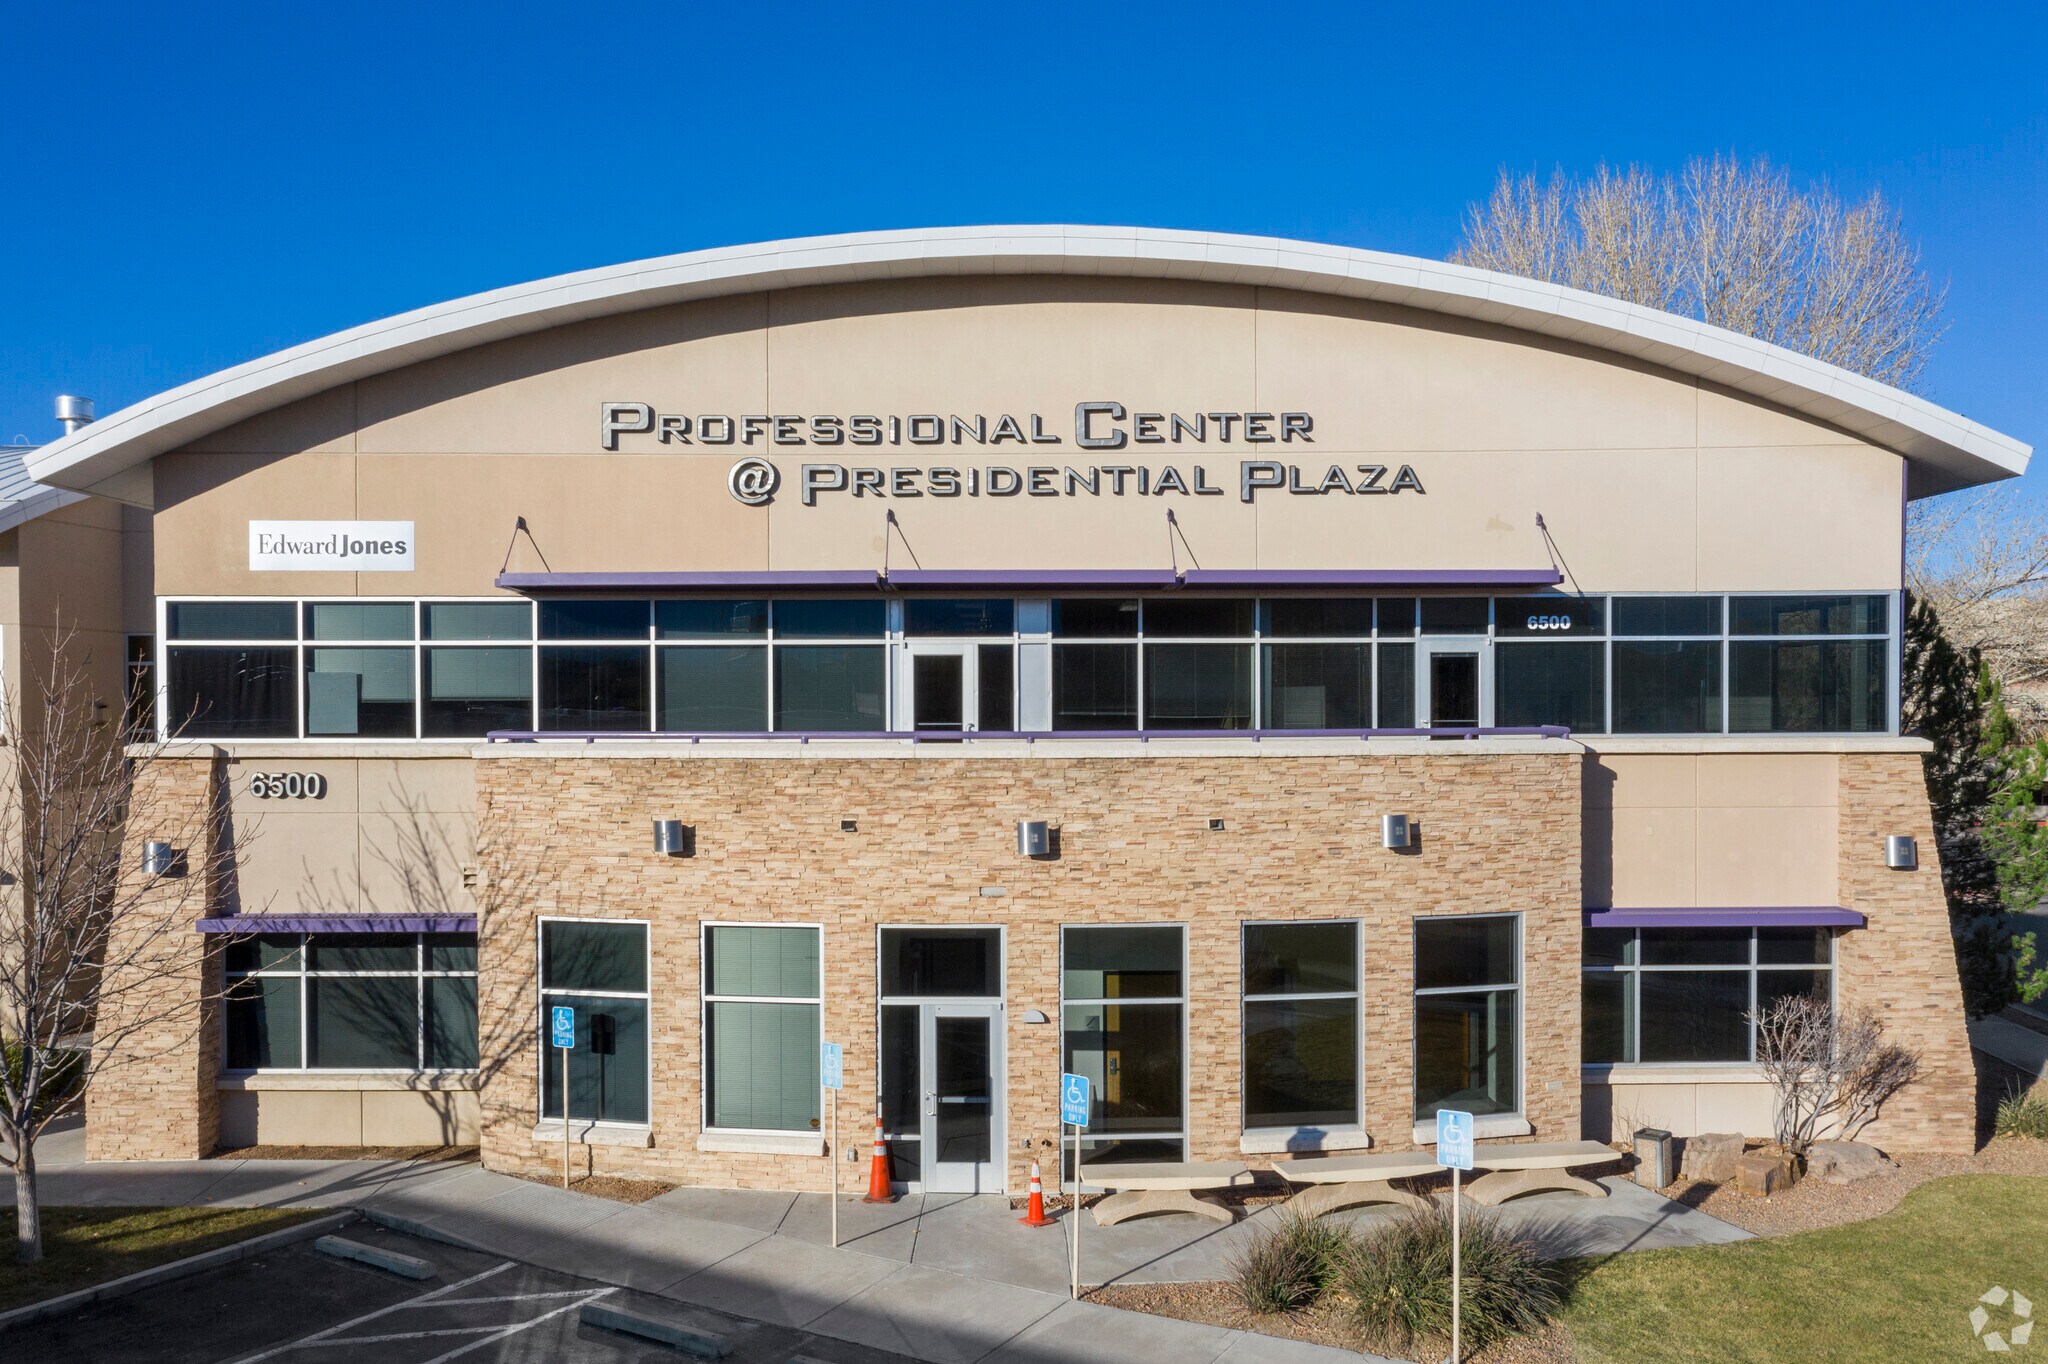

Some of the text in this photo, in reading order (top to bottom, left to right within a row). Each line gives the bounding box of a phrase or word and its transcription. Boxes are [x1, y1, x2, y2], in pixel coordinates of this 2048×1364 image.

[602, 402, 1315, 450] PROFESSIONAL CENTER
[727, 457, 1425, 506] @ PRESIDENTIAL PLAZA
[258, 533, 407, 558] Edward Jones
[1527, 615, 1571, 630] 6500
[250, 772, 323, 799] 6500
